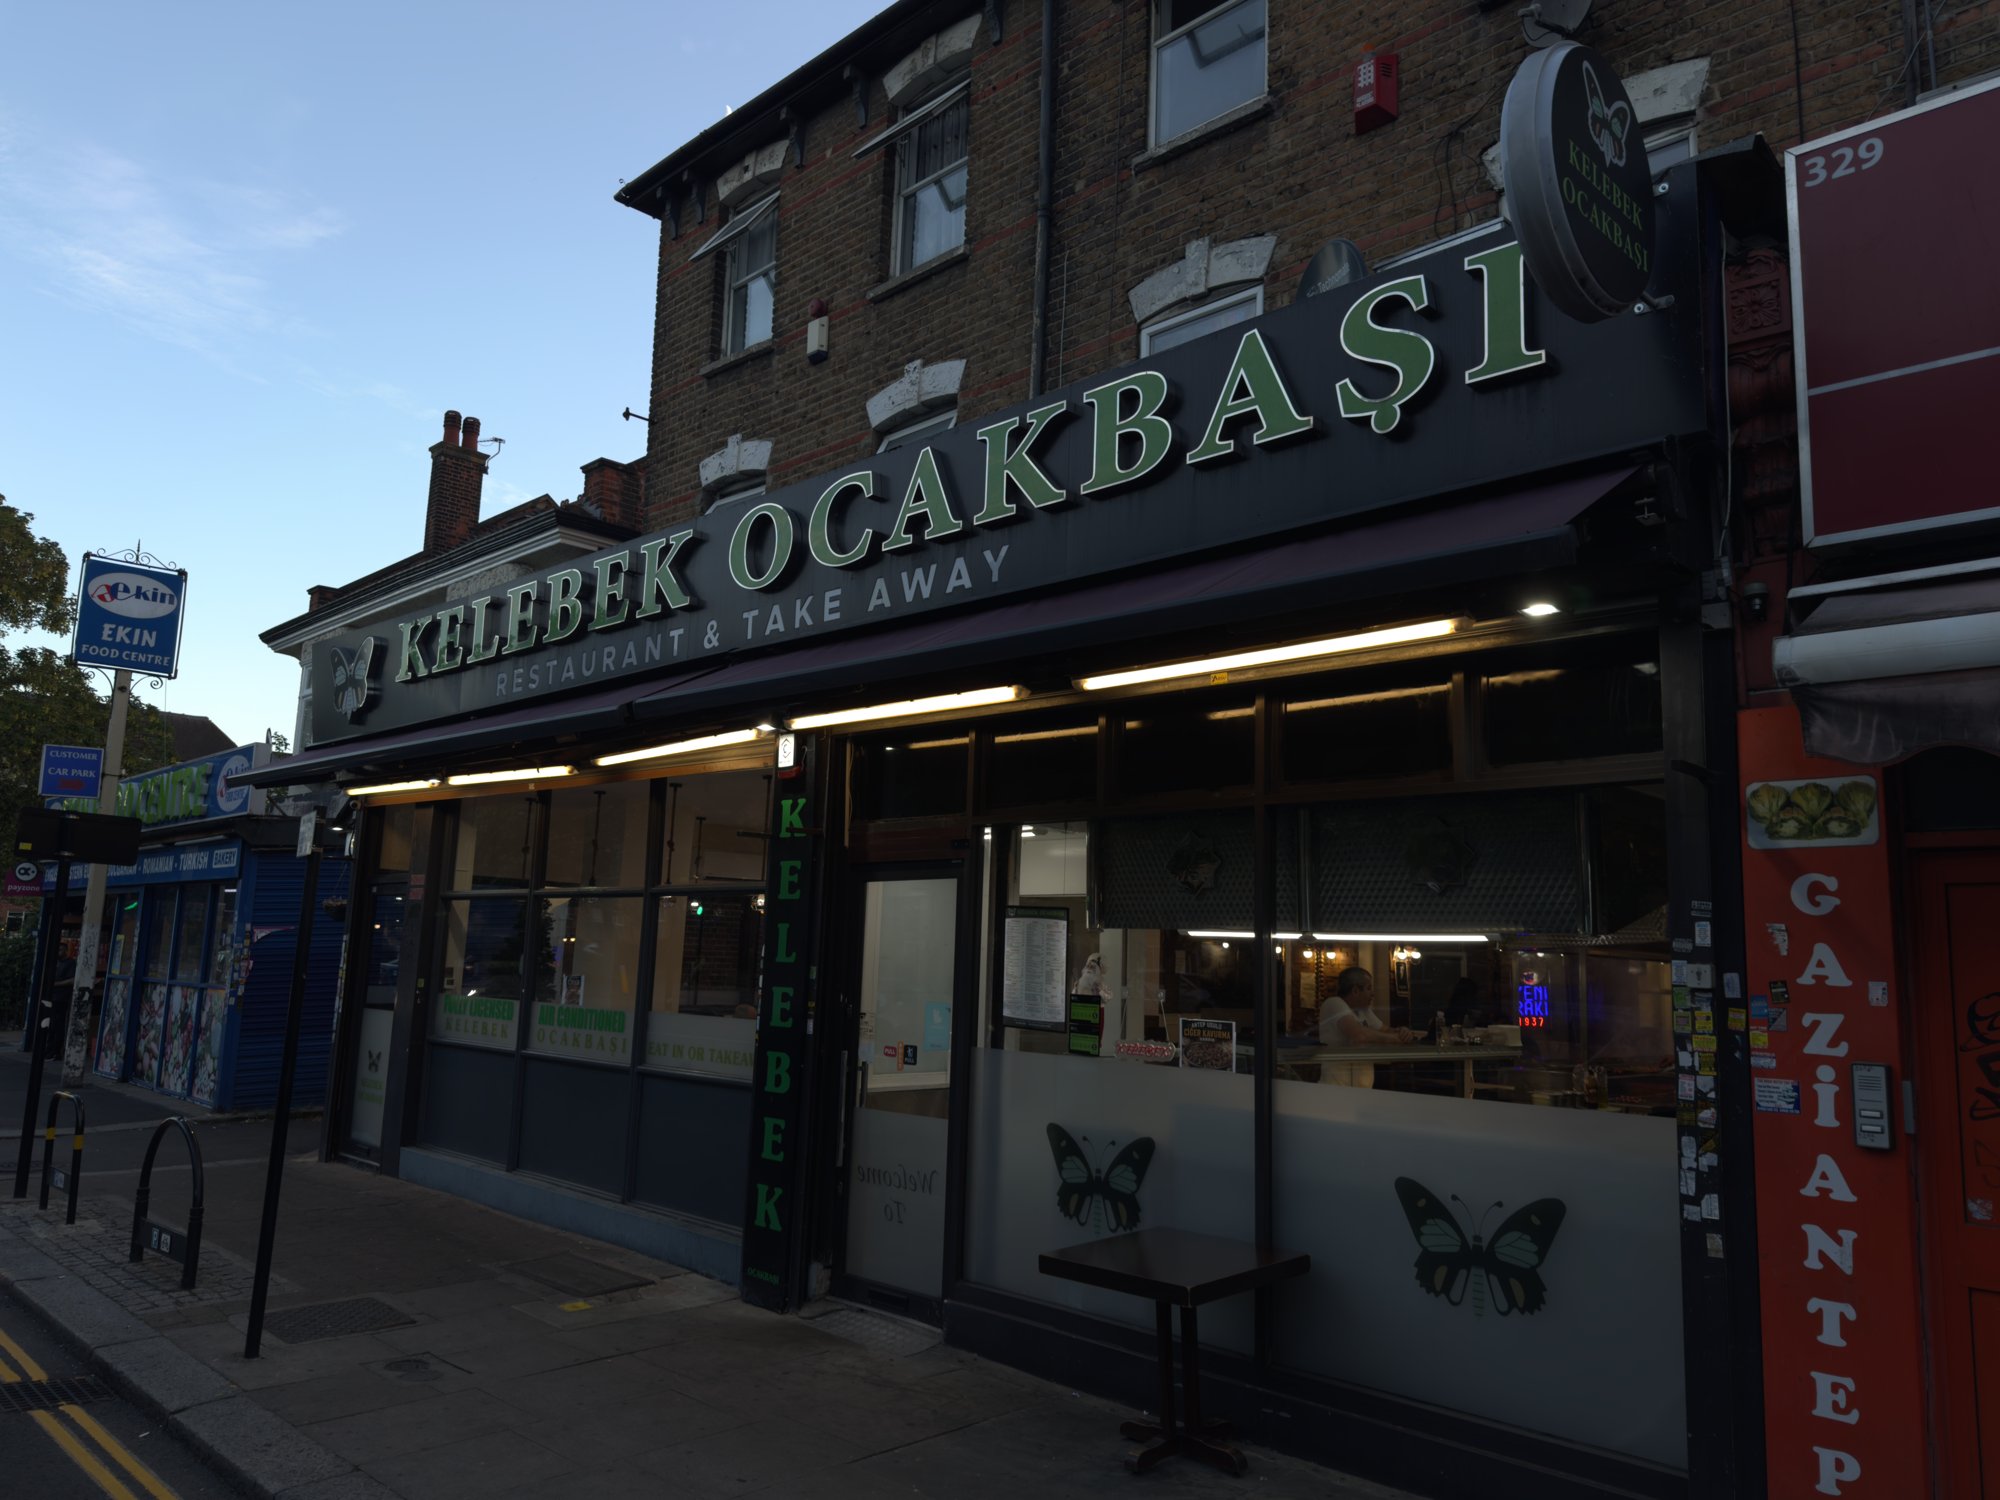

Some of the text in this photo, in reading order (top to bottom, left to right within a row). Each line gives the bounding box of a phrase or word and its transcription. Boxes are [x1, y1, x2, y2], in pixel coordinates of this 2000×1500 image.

[1804, 137, 1884, 187] 329
[1568, 138, 1643, 231] KELEBEK
[1563, 177, 1649, 273] OCAKBAŞI
[395, 240, 1548, 684] KELEBEK OCAKBAŞI
[496, 544, 1011, 698] RESTAURANT & TAKE AWAY
[101, 623, 157, 648] EKIN
[81, 644, 171, 667] FOOD CENTRE
[49, 750, 98, 761] CUSTOMER
[47, 767, 96, 778] CAR PARK
[143, 856, 175, 874] ROMANIAN
[179, 852, 209, 871] TURKISH
[214, 851, 236, 866] BAKERY
[7, 884, 41, 893] payzone
[469, 998, 514, 1021] LICENSED
[538, 1004, 626, 1033] AIR CONDITIONED
[754, 797, 808, 1232] KELEBEK
[445, 1017, 510, 1039] KELEBEK
[1518, 1016, 1545, 1028] 1937
[647, 1041, 669, 1057] EAT
[672, 1043, 685, 1059] IN
[687, 1046, 705, 1062] OR
[884, 1047, 896, 1055] PULL
